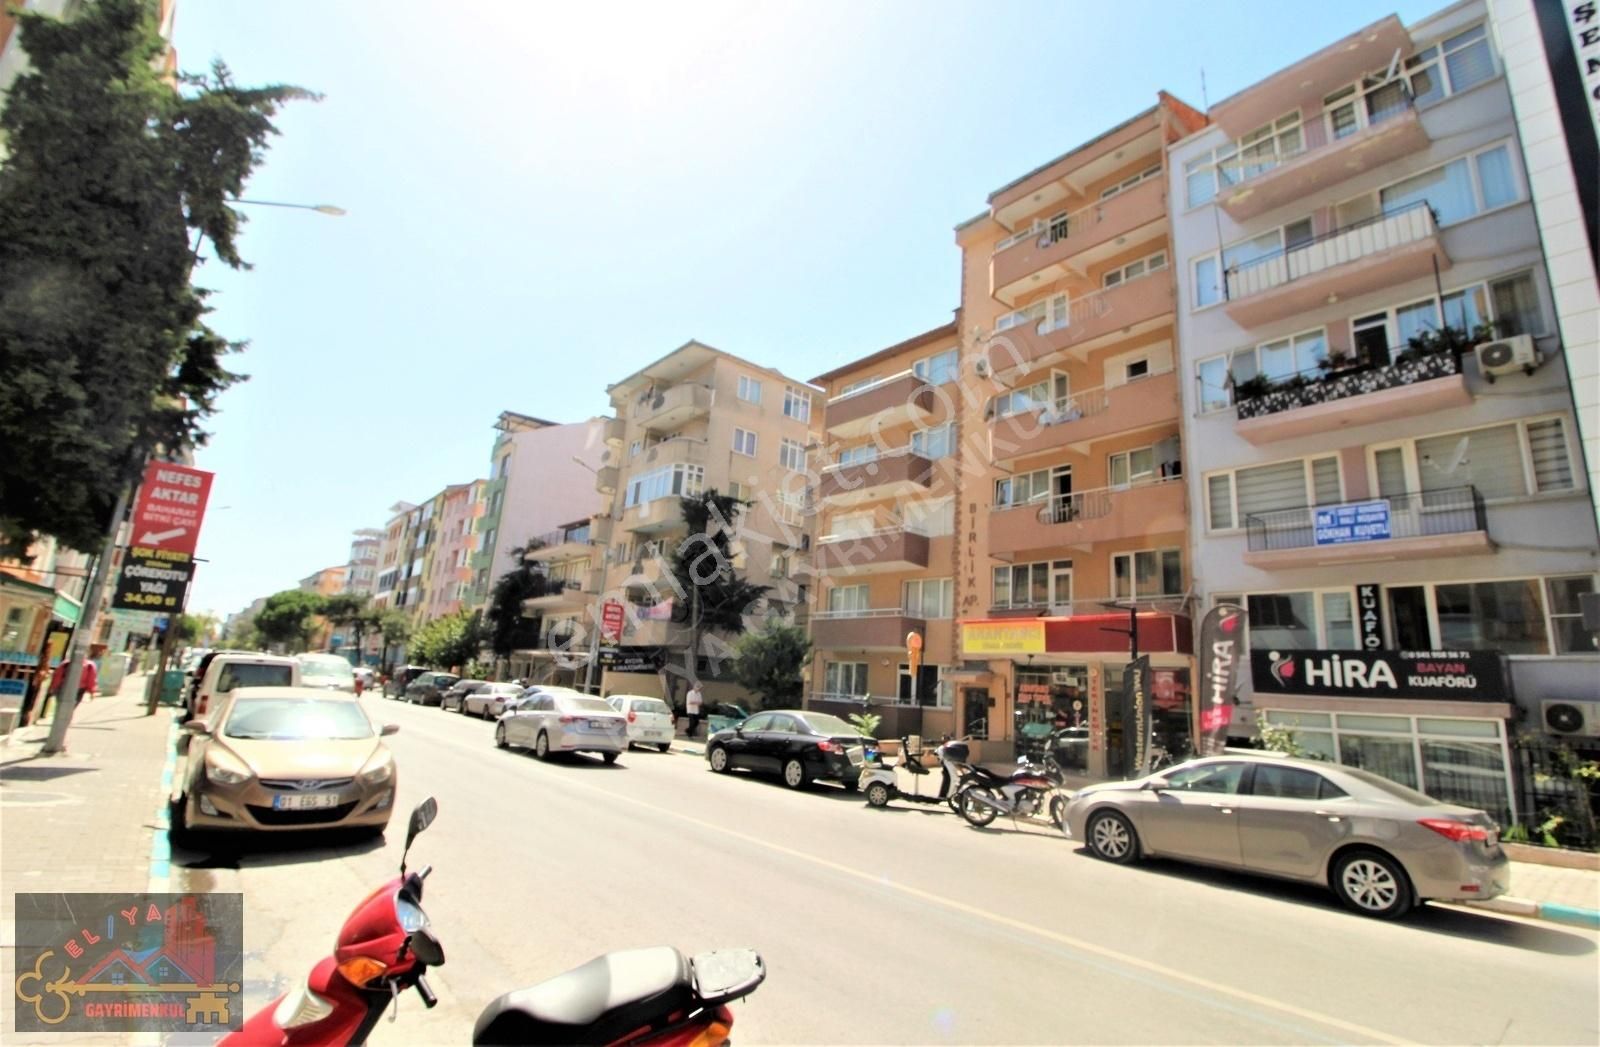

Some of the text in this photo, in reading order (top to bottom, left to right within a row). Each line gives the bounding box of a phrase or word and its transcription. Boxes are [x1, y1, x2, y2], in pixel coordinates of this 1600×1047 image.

[156, 469, 203, 488] NEFES
[150, 486, 200, 505] AKTAR
[1206, 640, 1235, 704] HİRA
[1305, 654, 1398, 689] HİRA
[1416, 662, 1465, 673] BAYAN
[1408, 674, 1477, 689] KUAFÖRÜ
